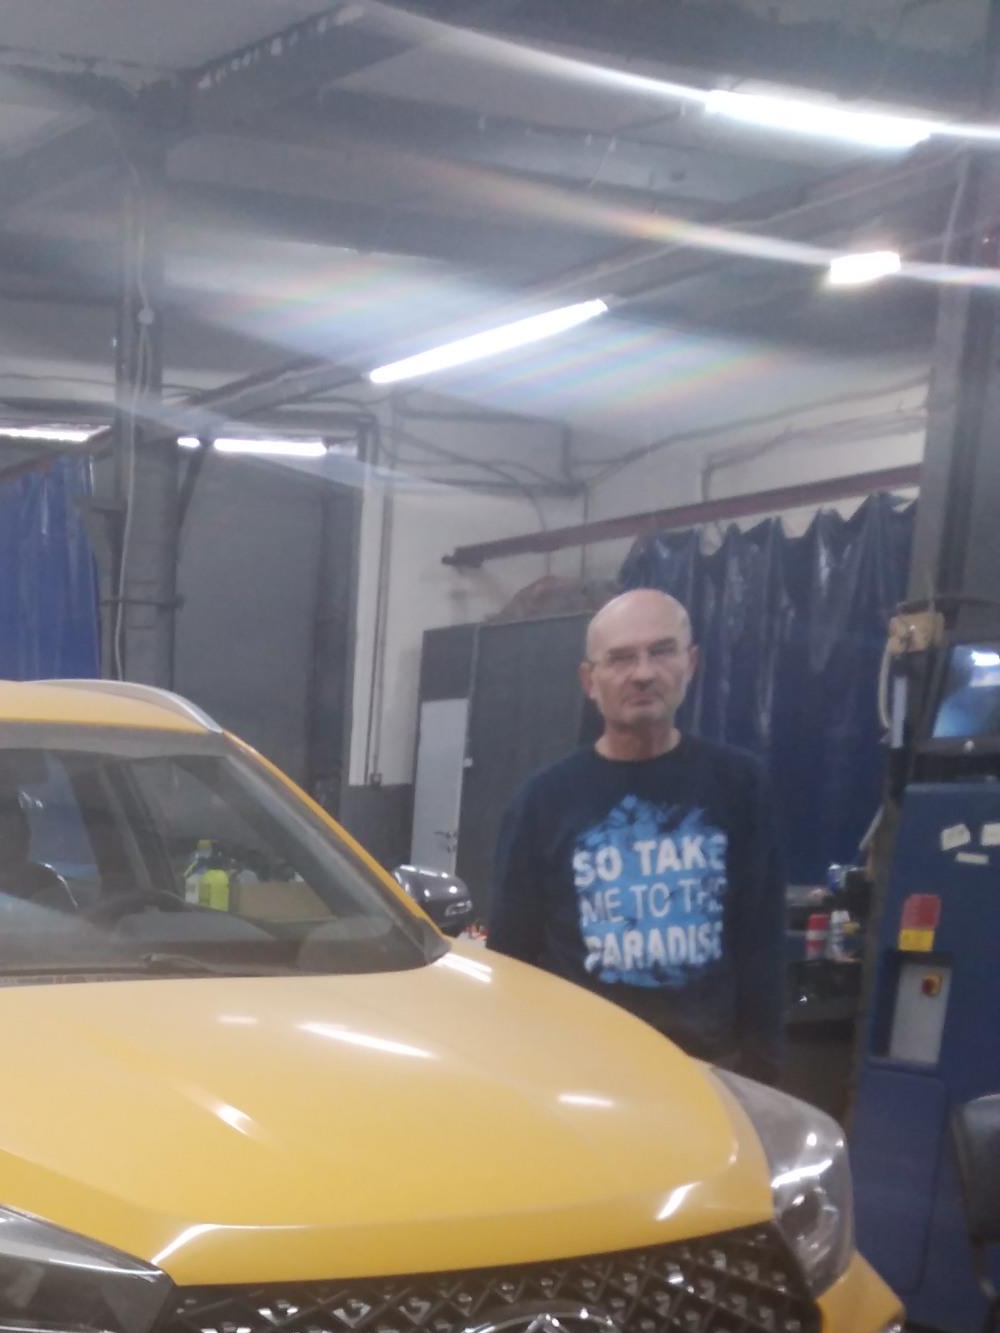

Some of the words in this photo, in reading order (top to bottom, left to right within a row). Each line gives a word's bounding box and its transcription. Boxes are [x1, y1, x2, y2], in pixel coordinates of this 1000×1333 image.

[573, 846, 622, 887] SO
[633, 834, 727, 876] TAKE
[581, 886, 624, 927] ME
[629, 882, 670, 920] TO
